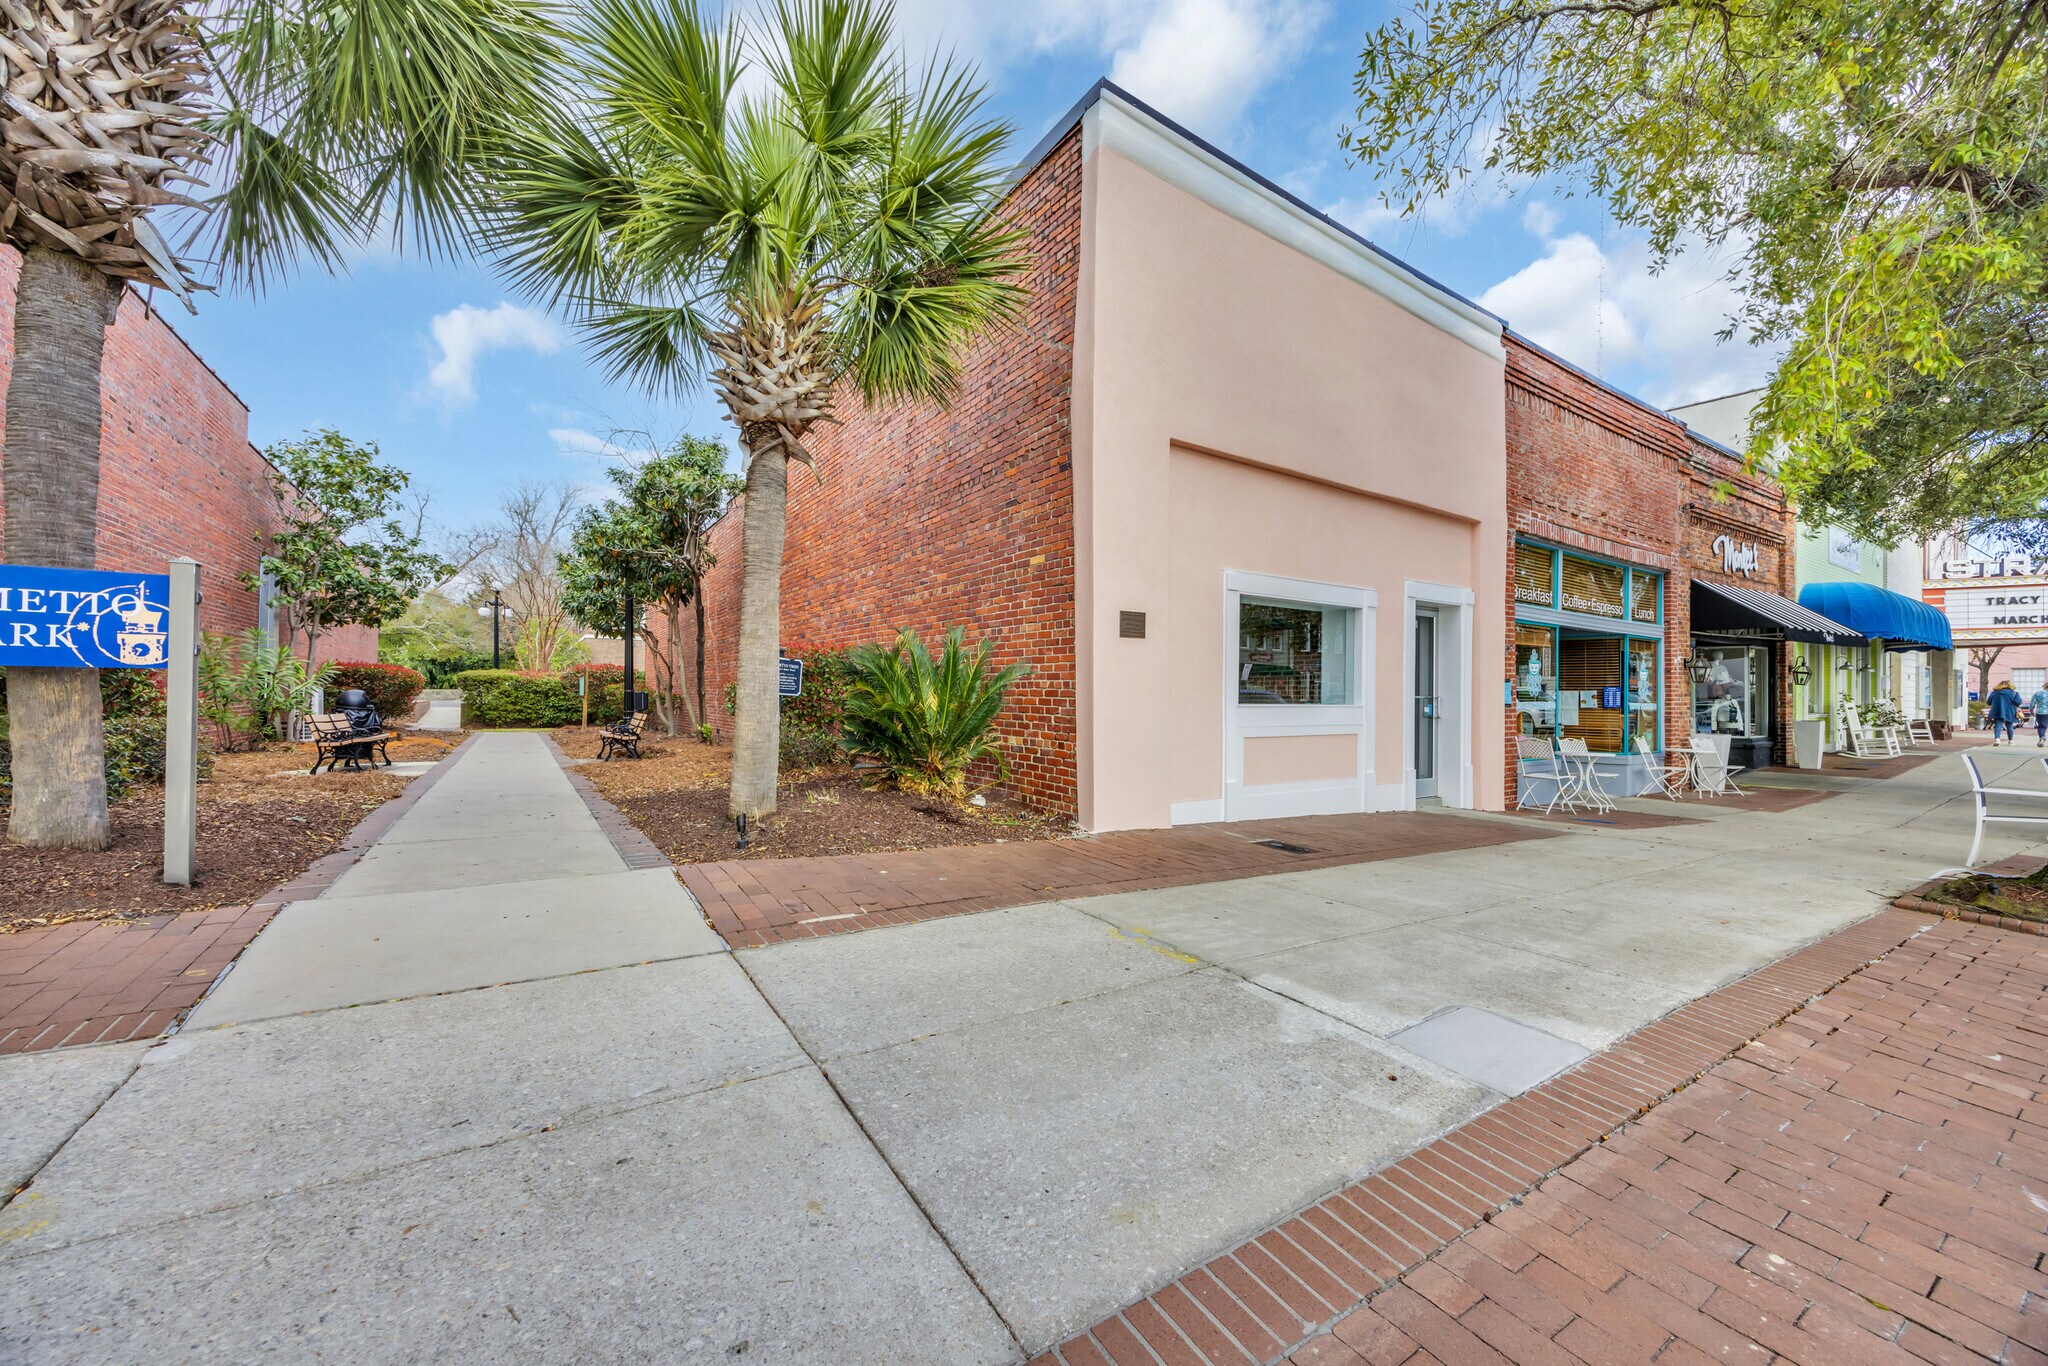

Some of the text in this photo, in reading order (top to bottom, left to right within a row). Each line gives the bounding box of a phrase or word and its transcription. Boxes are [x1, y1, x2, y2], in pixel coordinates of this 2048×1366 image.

[1985, 595, 2041, 606] TRACY
[1634, 604, 1655, 621] Lunch
[1993, 614, 2048, 625] MARCH
[0, 622, 78, 648] RK
